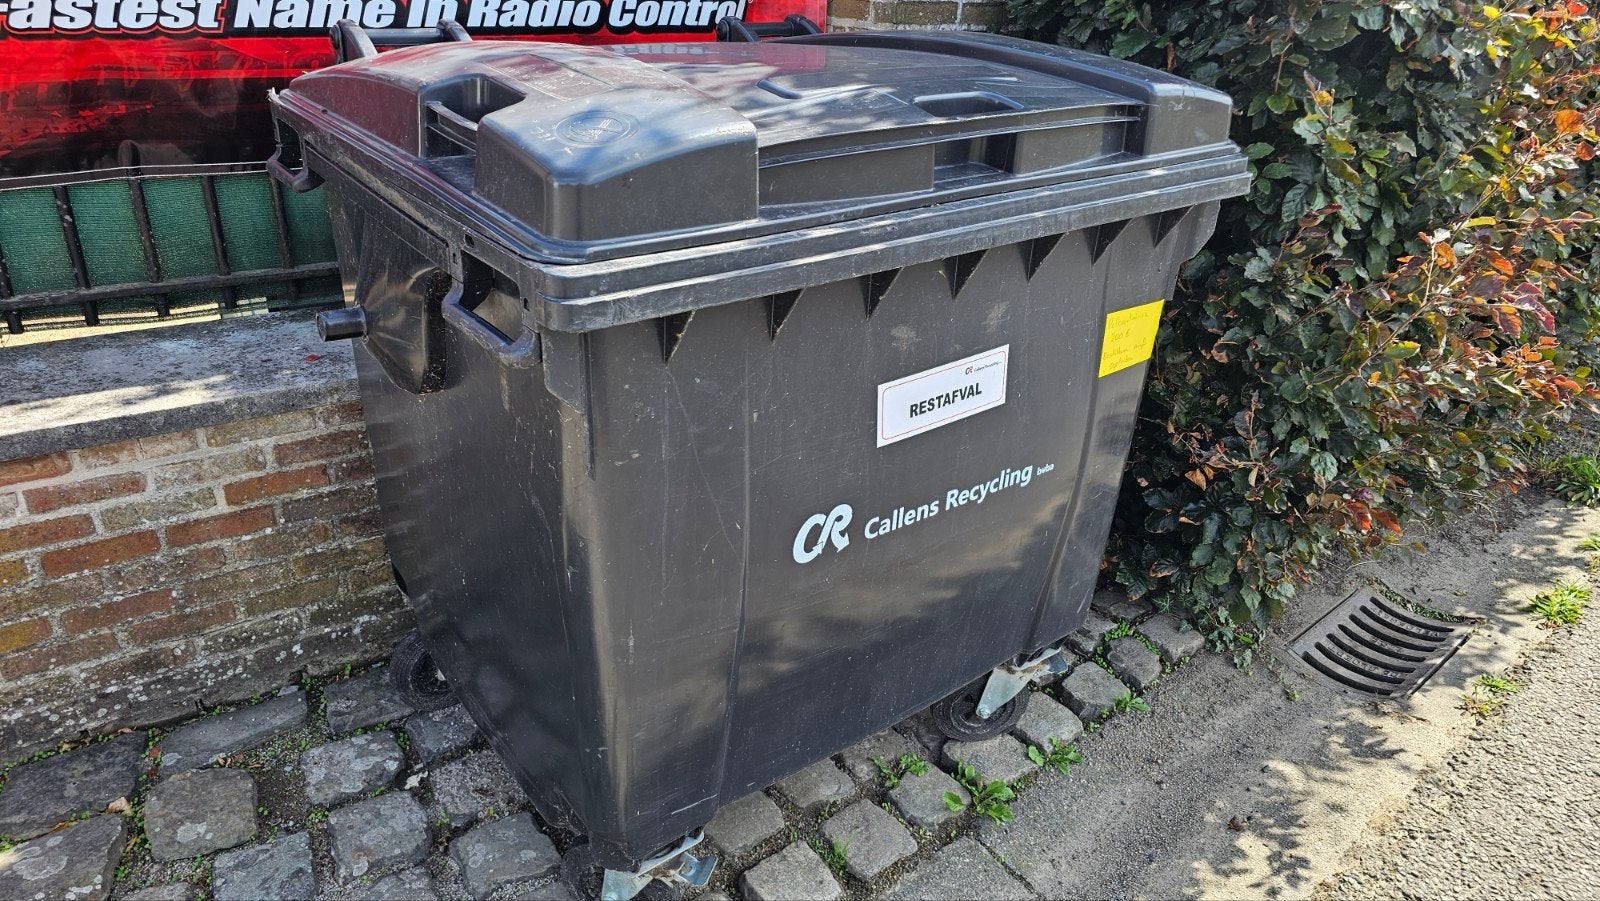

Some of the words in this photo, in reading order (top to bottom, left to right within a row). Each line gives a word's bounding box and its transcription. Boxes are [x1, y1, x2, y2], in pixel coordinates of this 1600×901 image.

[0, 0, 222, 29] astest
[233, 0, 396, 28] Name
[406, 0, 458, 27] In
[467, 0, 600, 27] Radio
[608, 0, 746, 27] Control
[909, 382, 982, 418] RESTAFVAL
[793, 503, 853, 564] CR
[864, 499, 939, 539] Callens
[945, 464, 1033, 512] Recycling
[1036, 463, 1054, 476] bvba
